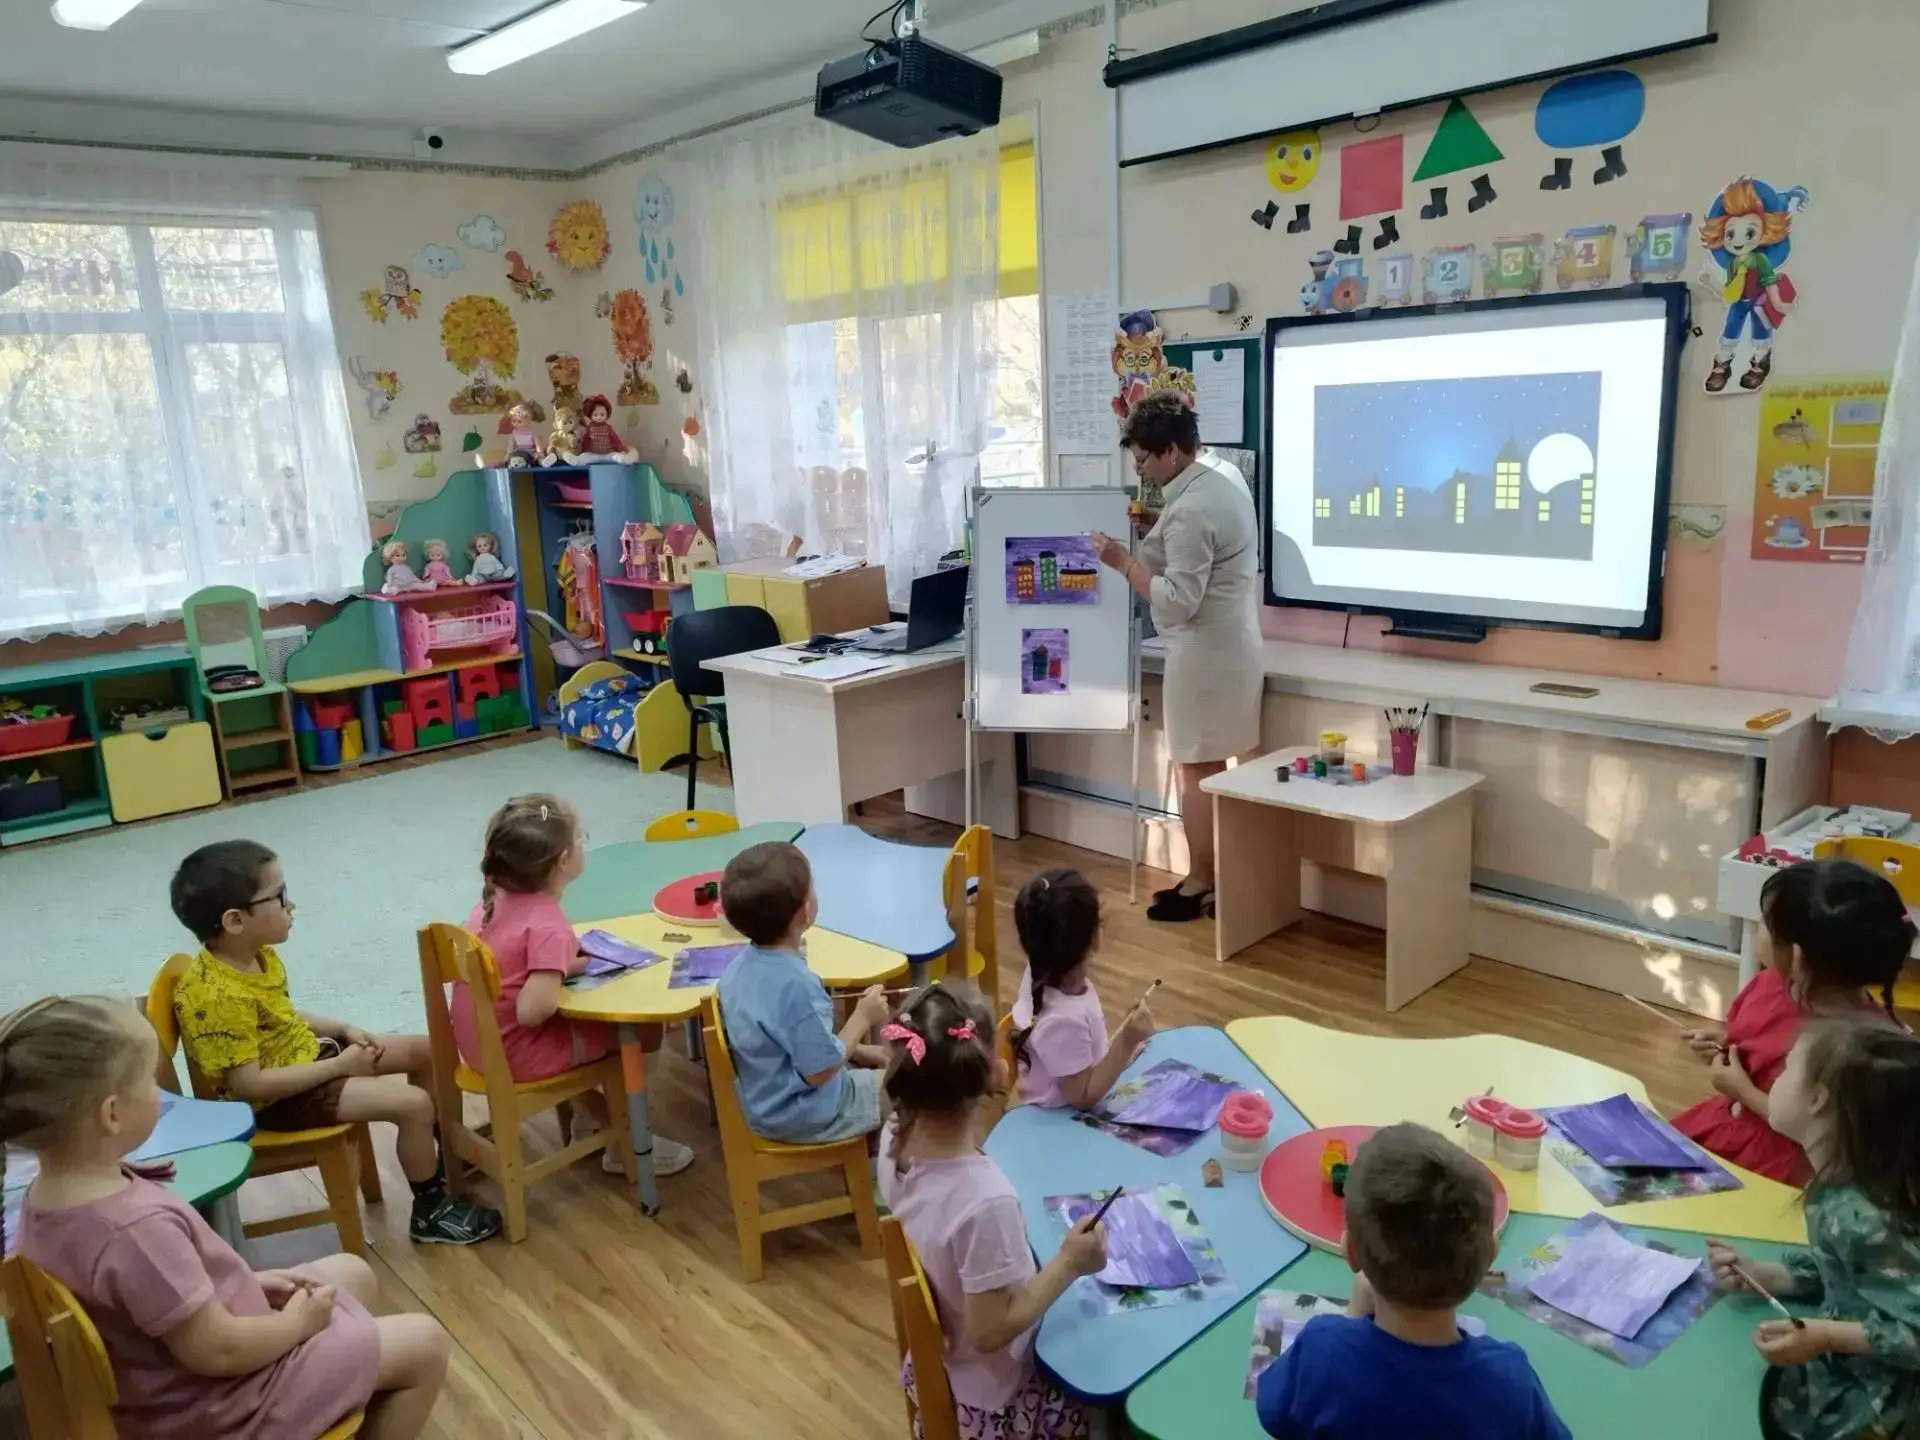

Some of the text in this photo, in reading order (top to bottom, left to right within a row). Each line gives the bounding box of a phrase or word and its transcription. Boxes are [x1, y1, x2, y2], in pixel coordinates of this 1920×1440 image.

[1575, 243, 1597, 264] 4
[1652, 233, 1673, 257] 5
[1440, 261, 1459, 282] 2
[1503, 252, 1521, 273] 3
[1388, 265, 1398, 284] 1
